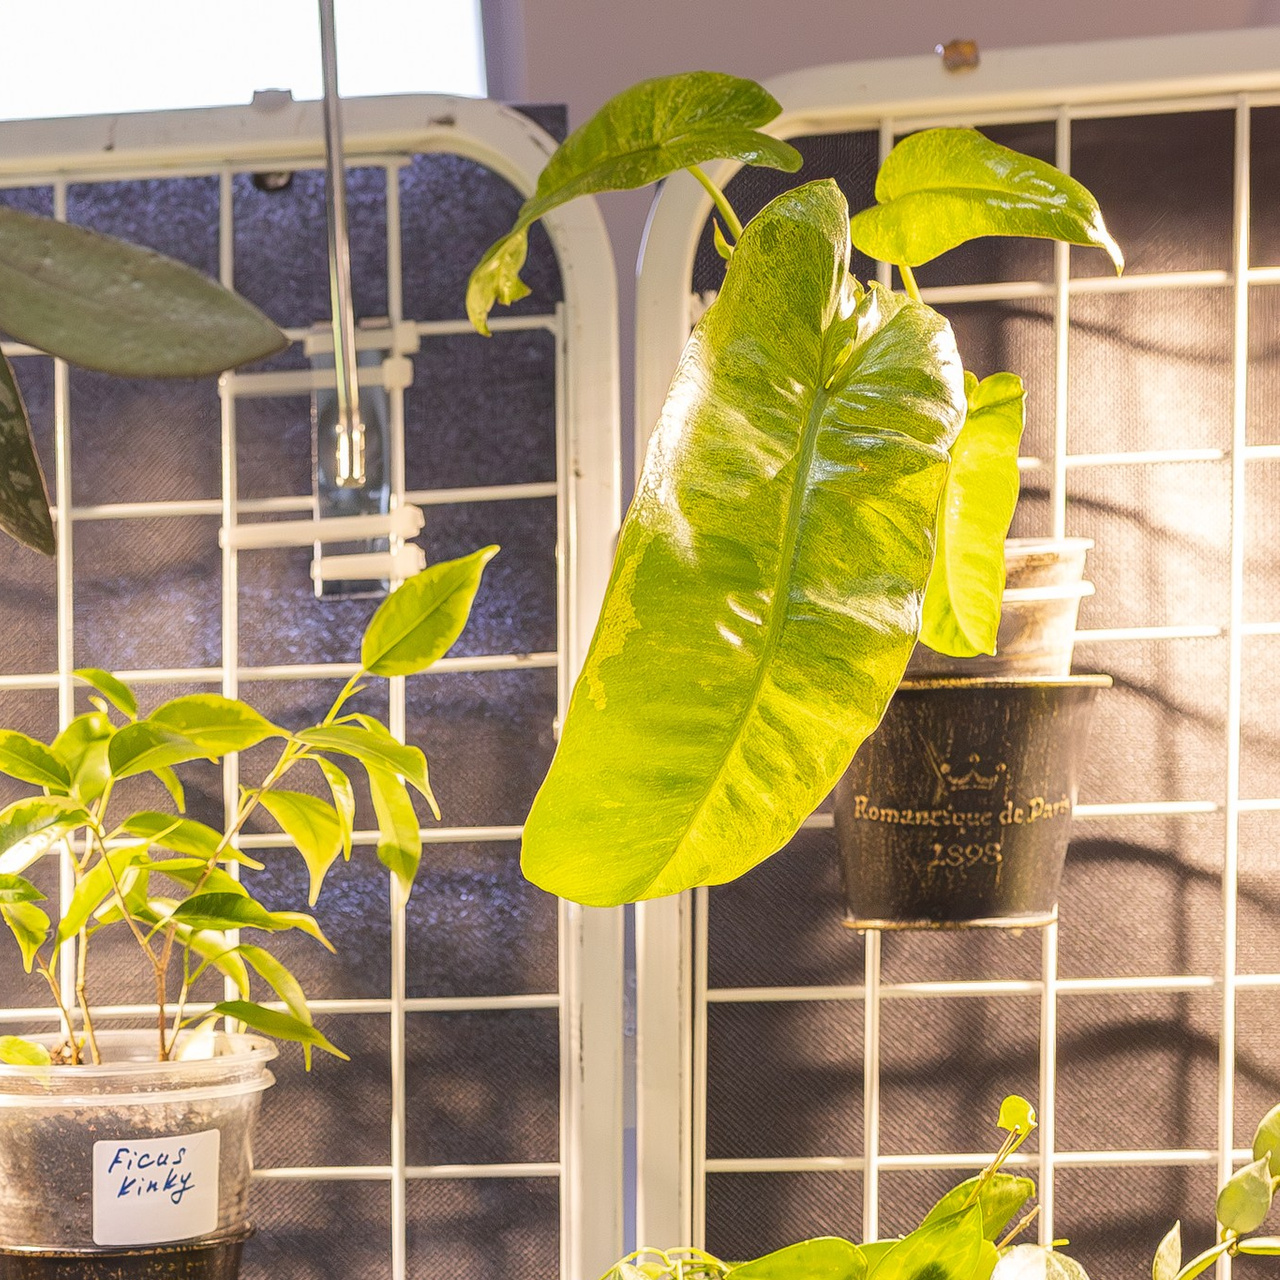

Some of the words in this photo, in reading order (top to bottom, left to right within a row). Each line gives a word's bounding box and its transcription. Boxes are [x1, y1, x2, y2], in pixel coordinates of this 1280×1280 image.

[999, 801, 1024, 825] de
[108, 1147, 186, 1173] Ficus
[117, 1168, 195, 1205] Kinky
